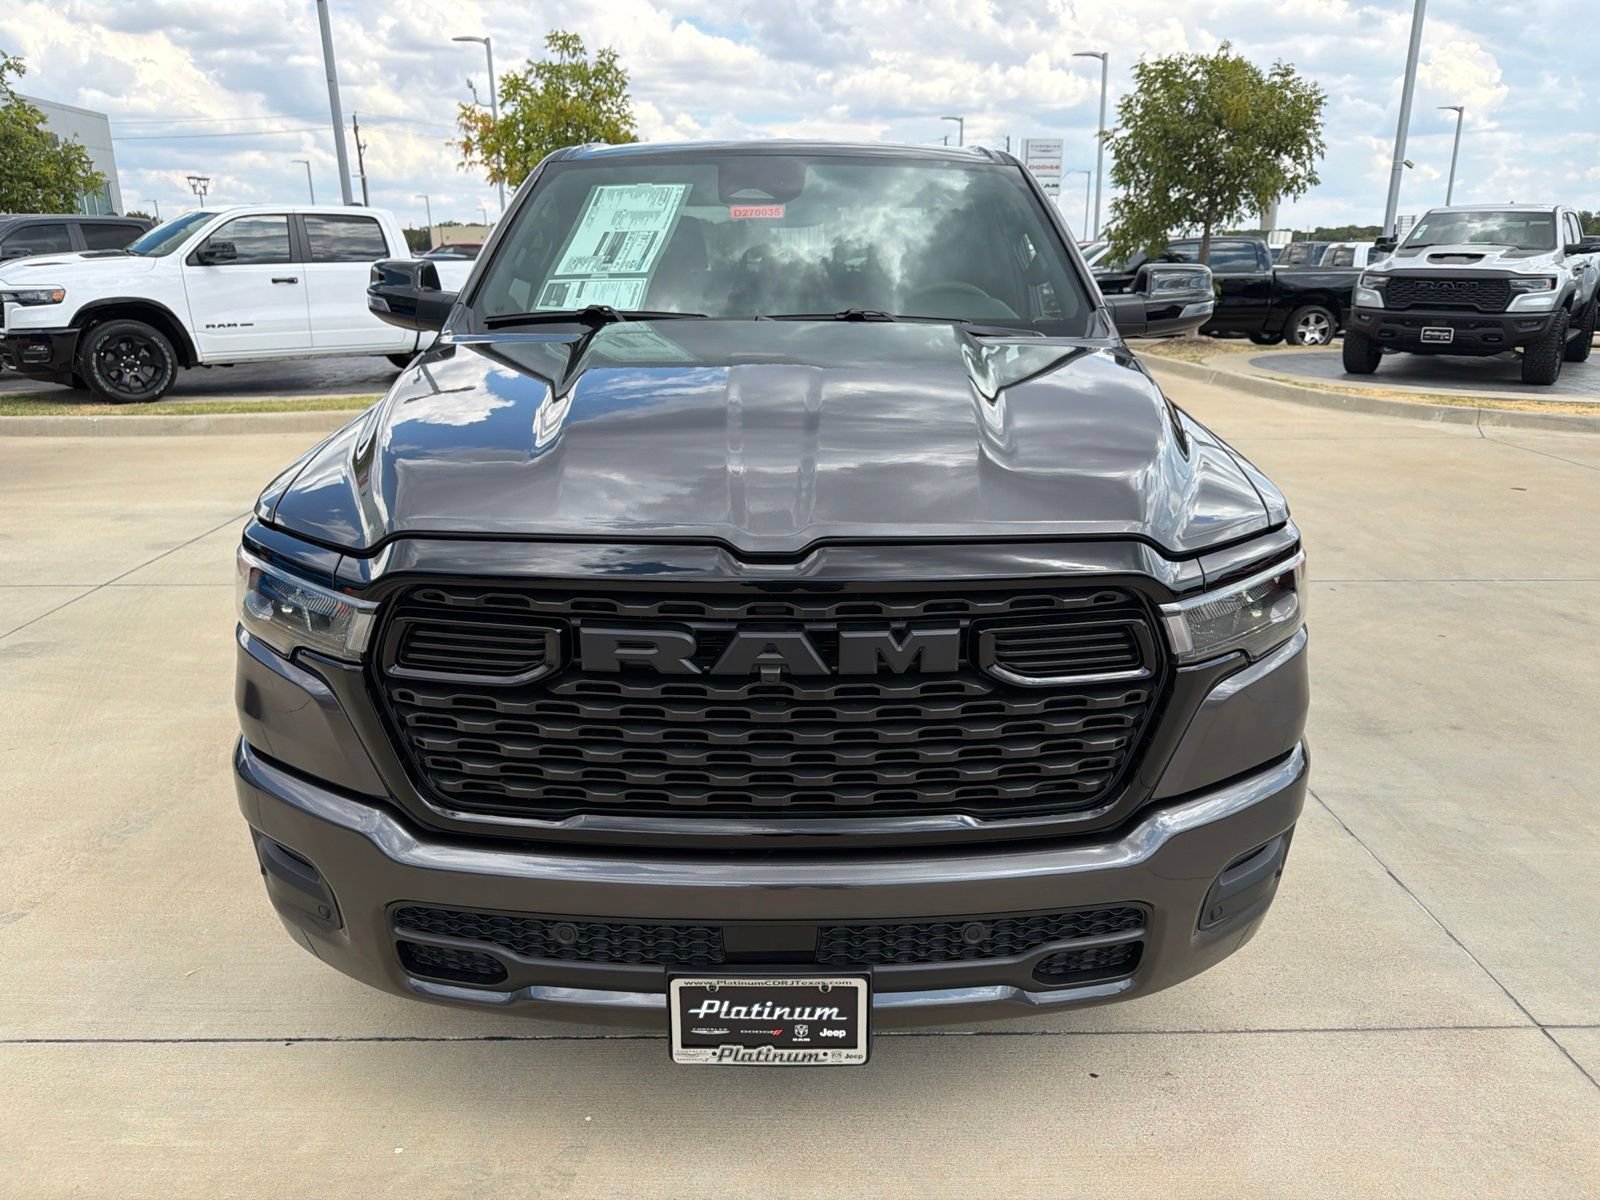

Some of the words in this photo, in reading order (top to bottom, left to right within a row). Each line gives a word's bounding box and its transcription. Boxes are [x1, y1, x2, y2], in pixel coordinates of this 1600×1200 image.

[733, 208, 781, 217] D270035
[580, 621, 961, 676] RAM
[688, 1000, 847, 1020] Platinum
[819, 1028, 846, 1039] Jeep
[717, 1046, 827, 1062] Platinum
